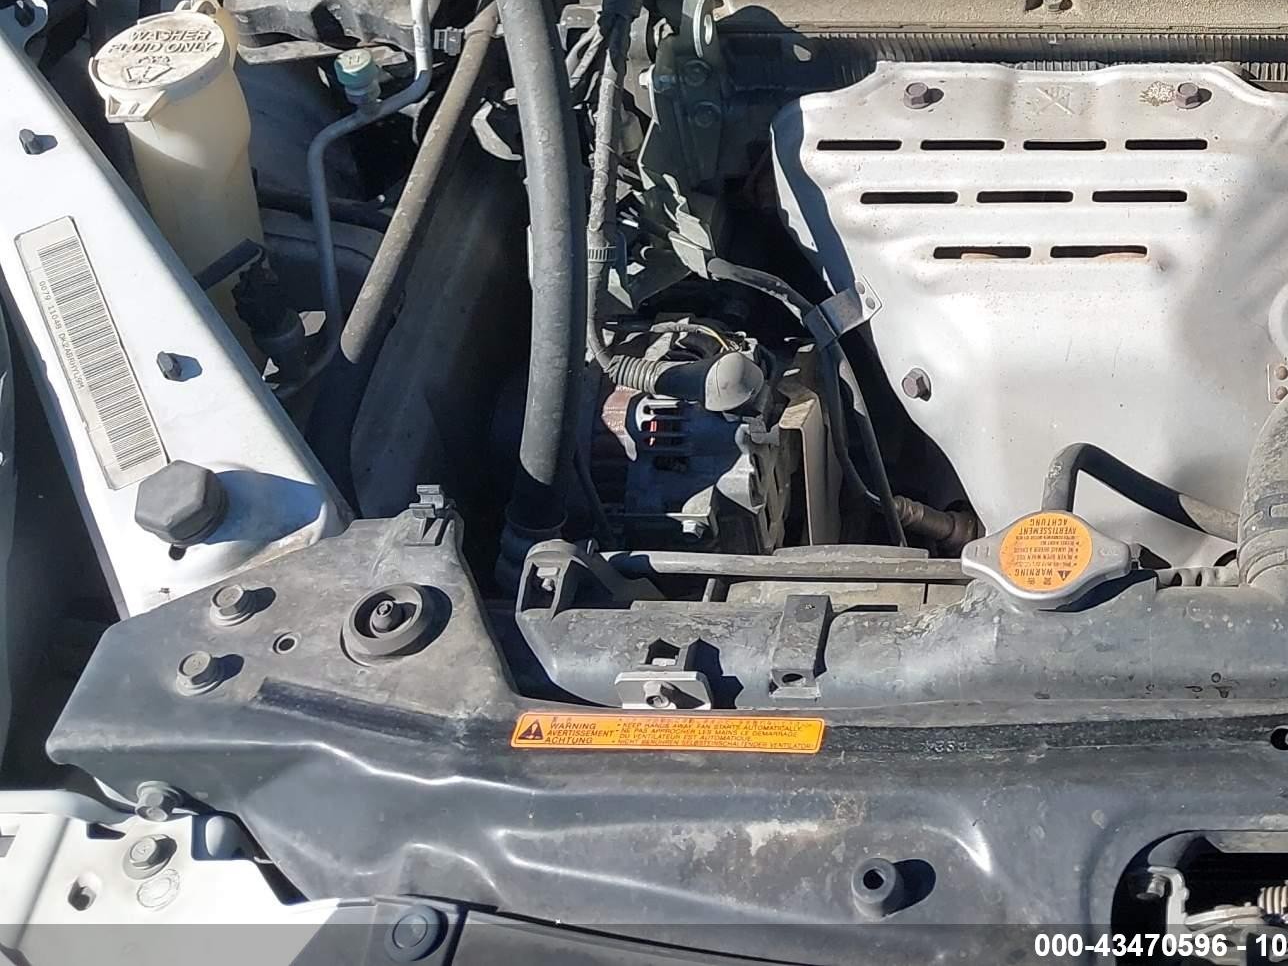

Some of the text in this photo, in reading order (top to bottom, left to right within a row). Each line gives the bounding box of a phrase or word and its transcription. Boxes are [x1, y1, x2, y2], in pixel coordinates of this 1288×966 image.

[131, 30, 212, 42] WASHER
[108, 41, 217, 54] FLUID ONLY
[1029, 518, 1068, 526] ACHTUNG
[1018, 527, 1077, 535] AVERTISSEMENT
[1014, 568, 1053, 577] WARNING
[551, 722, 597, 730] WARNING
[547, 729, 613, 737] AVERTISSEMENT
[544, 736, 593, 744] ACHTUNG
